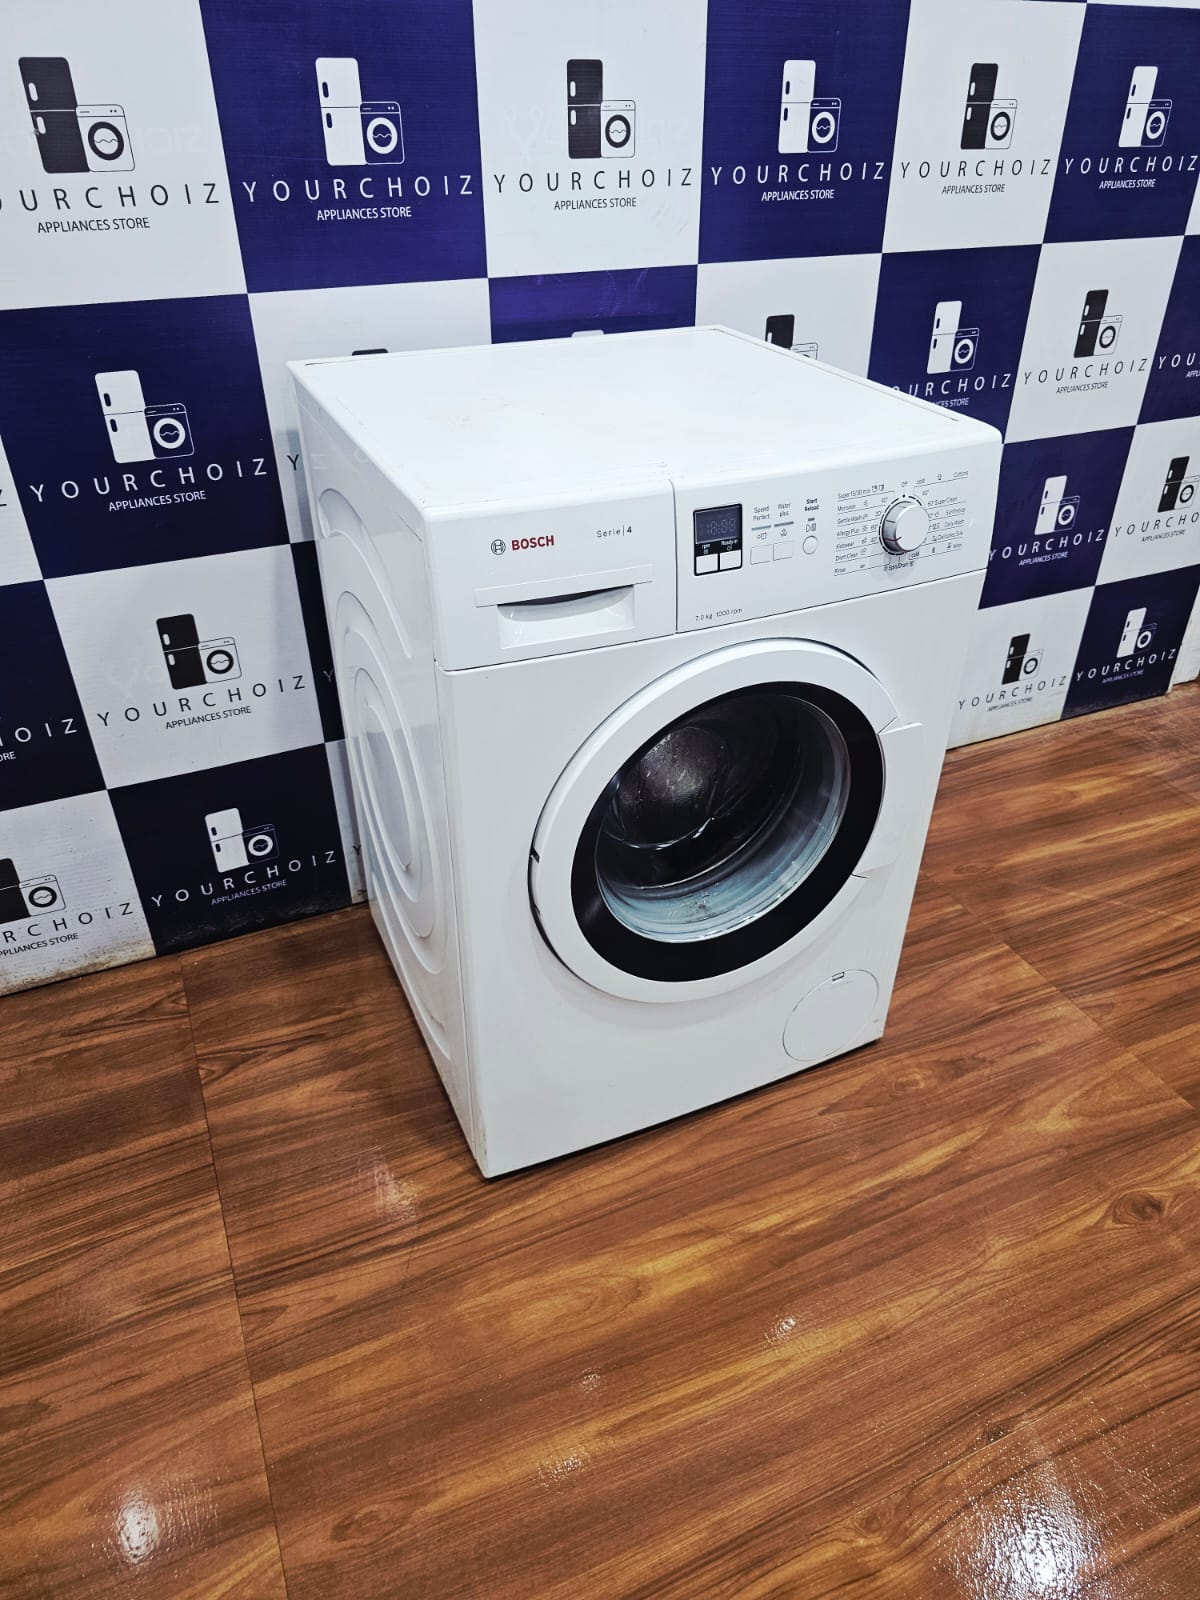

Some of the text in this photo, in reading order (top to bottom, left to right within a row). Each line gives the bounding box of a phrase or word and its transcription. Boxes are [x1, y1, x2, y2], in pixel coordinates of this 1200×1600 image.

[711, 162, 885, 185] YOURCHOIZ
[900, 159, 1051, 179] YOURCHOIZ
[1064, 155, 1198, 174] YOURCHOIZ
[243, 175, 473, 203] YOURCHOIZ
[494, 168, 692, 193] YOURCHOIZ
[942, 184, 1005, 194] APPLIANCES STORE
[1099, 178, 1156, 189] APPLIANCES STORE
[0, 183, 219, 211] URCHOIZ
[554, 197, 637, 211] APPLIANCES STORE
[761, 189, 835, 202] APPLIANCES STORE
[316, 206, 412, 221] APPLIANCES STORE
[37, 218, 150, 234] APPLIANCES STORE
[1023, 358, 1148, 385] YOURCHOIZ
[1056, 381, 1108, 394] APPLIANCES STORE
[29, 457, 267, 503] YOURCHOIZ
[108, 490, 207, 511] APPLIANCES STORE
[754, 504, 770, 513] Speed
[804, 504, 820, 512] Reload
[753, 513, 770, 522] Perfect
[511, 535, 555, 551] BOSCH
[596, 528, 621, 538] Serie
[988, 529, 1105, 561] YOURCHOIZ
[1076, 648, 1177, 682] YOURCHOIZ
[97, 675, 306, 727] YOURCHOIZ
[958, 675, 1067, 710] YOURCHOIZ
[165, 705, 252, 730] APPLIANCES STORE
[151, 851, 336, 907] YOURCHOIZ
[211, 879, 288, 905] APPLIANCES STORE
[48, 932, 80, 946] STORE
